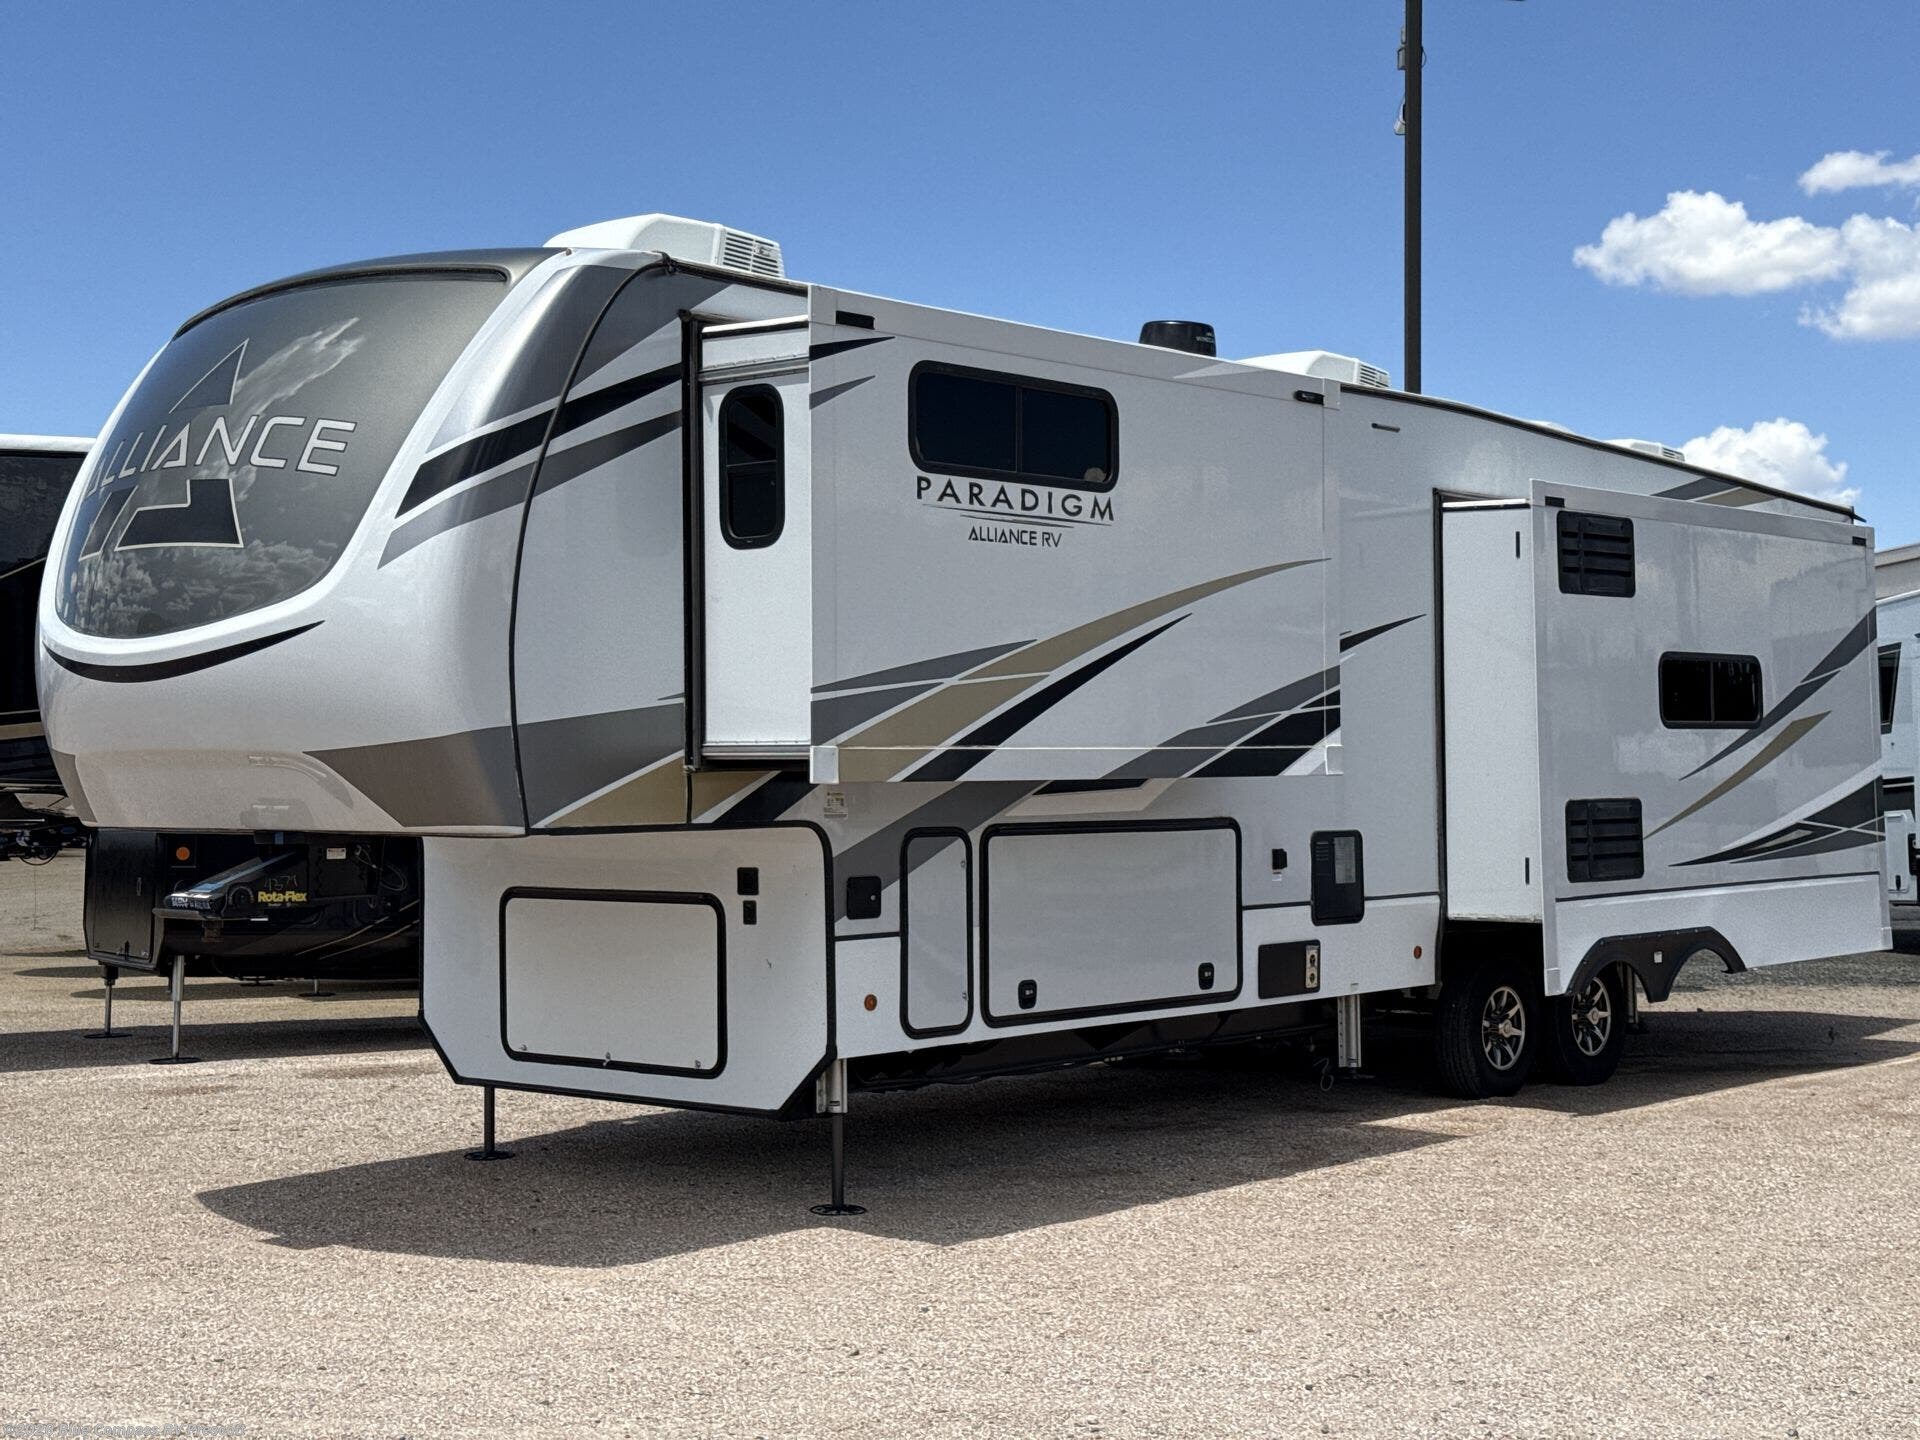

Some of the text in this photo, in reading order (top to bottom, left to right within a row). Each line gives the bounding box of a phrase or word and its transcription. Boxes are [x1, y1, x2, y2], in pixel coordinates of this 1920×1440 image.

[916, 475, 1115, 521] PARADIGM
[968, 526, 1062, 548] ALLIANCE RV
[257, 891, 308, 904] Rota-Flex
